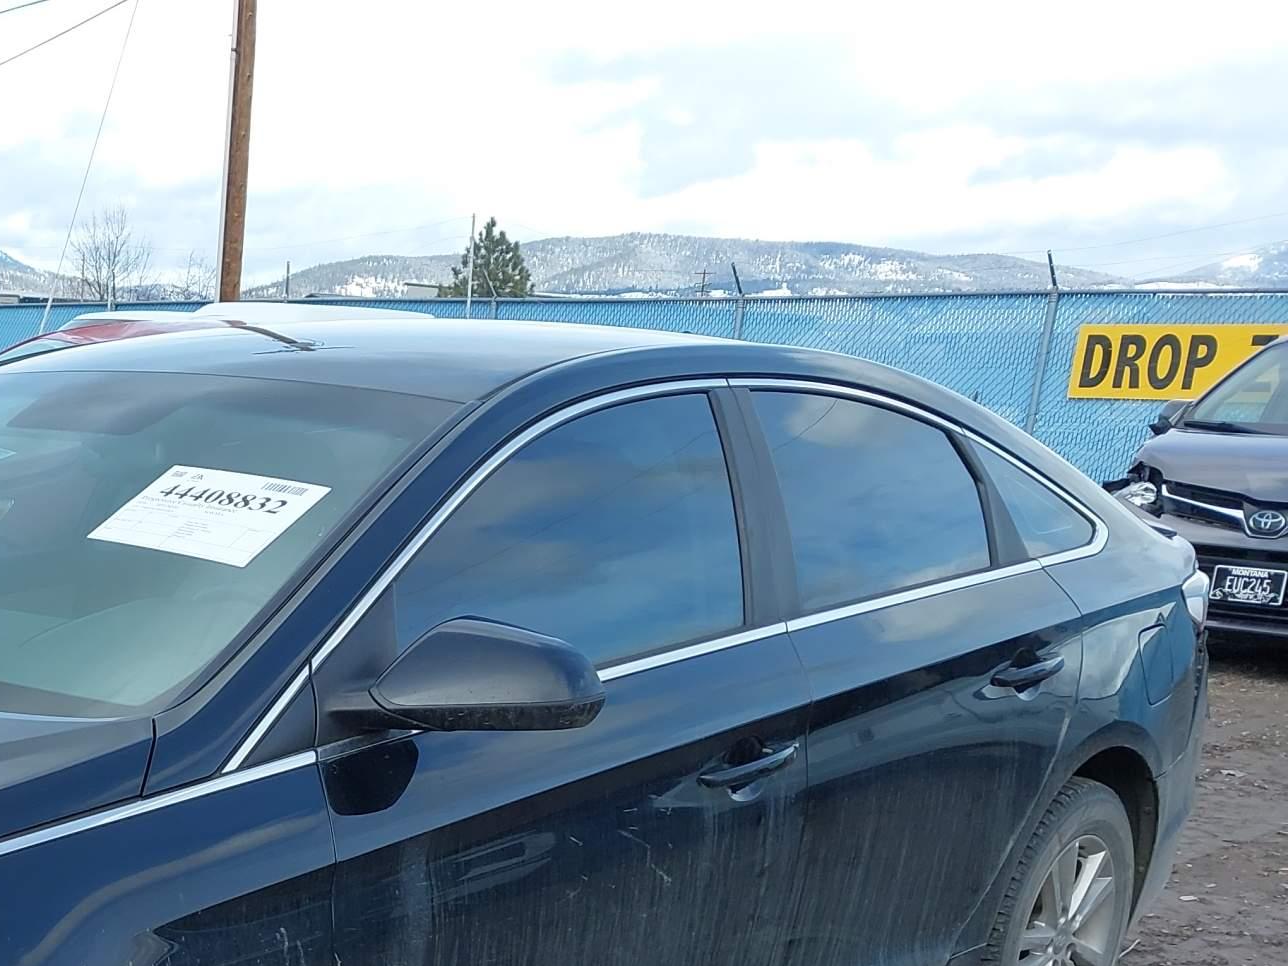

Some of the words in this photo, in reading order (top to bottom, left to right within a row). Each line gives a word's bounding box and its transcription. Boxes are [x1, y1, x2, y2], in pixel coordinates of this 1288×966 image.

[1078, 333, 1219, 391] DROP
[159, 483, 289, 515] 44408832
[1225, 575, 1272, 596] EUC245
[1231, 568, 1269, 578] MONTANA
